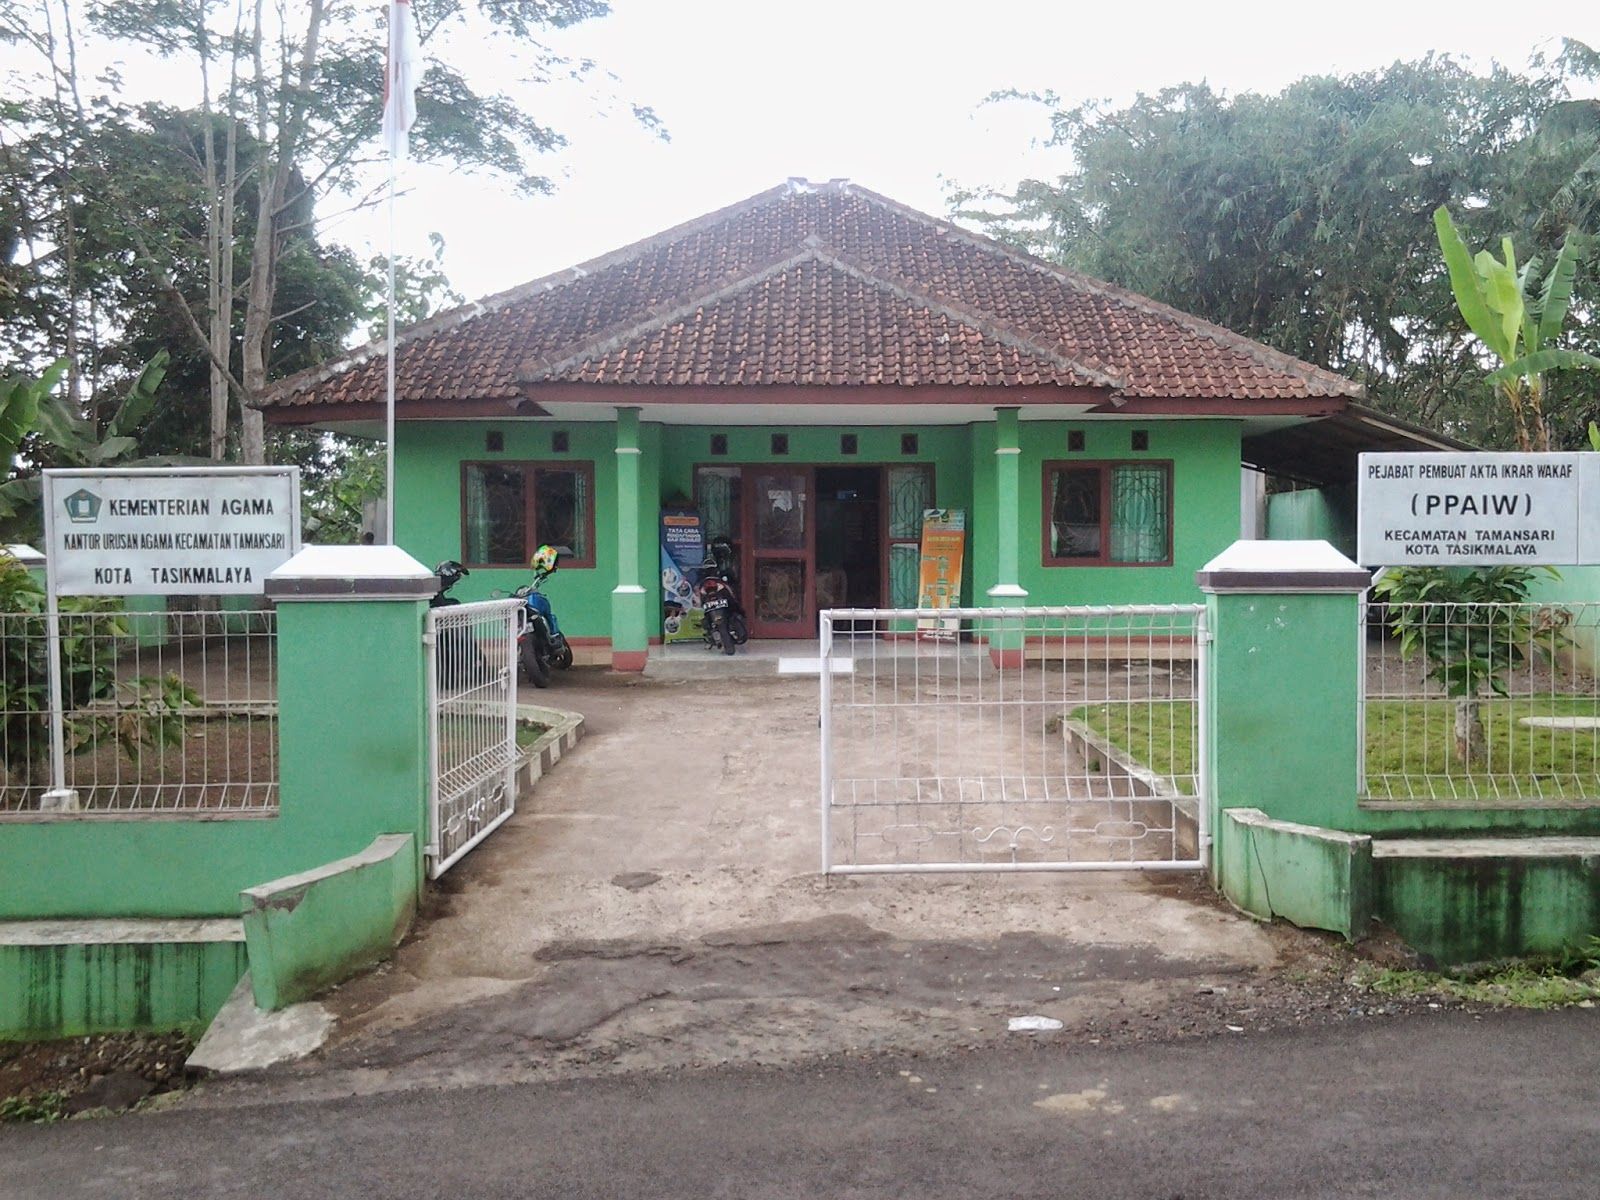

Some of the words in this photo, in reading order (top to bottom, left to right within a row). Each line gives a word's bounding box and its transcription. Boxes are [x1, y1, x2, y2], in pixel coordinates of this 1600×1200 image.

[1368, 464, 1414, 479] PEJABAT
[1419, 464, 1467, 479] PEMBUAT
[1469, 464, 1498, 479] AKTA
[1501, 464, 1534, 479] IKRAR
[1537, 464, 1573, 479] WAKAF
[109, 499, 210, 516] KEMENTERIAN
[221, 499, 274, 516] AGAMA
[63, 533, 100, 550] KANTOR
[103, 533, 138, 550] URUSAN
[140, 533, 173, 550] AGAMA
[175, 533, 231, 550] KECAMATAN
[233, 533, 285, 550] TAMANSARI
[1384, 530, 1467, 541] KECAMATAN
[1475, 530, 1555, 541] TAMANSARI
[1405, 544, 1440, 556] KOTA
[1446, 544, 1537, 556] TASIKMALAYA
[94, 567, 132, 584] KOTA
[151, 567, 252, 584] TASIKMALAYA
